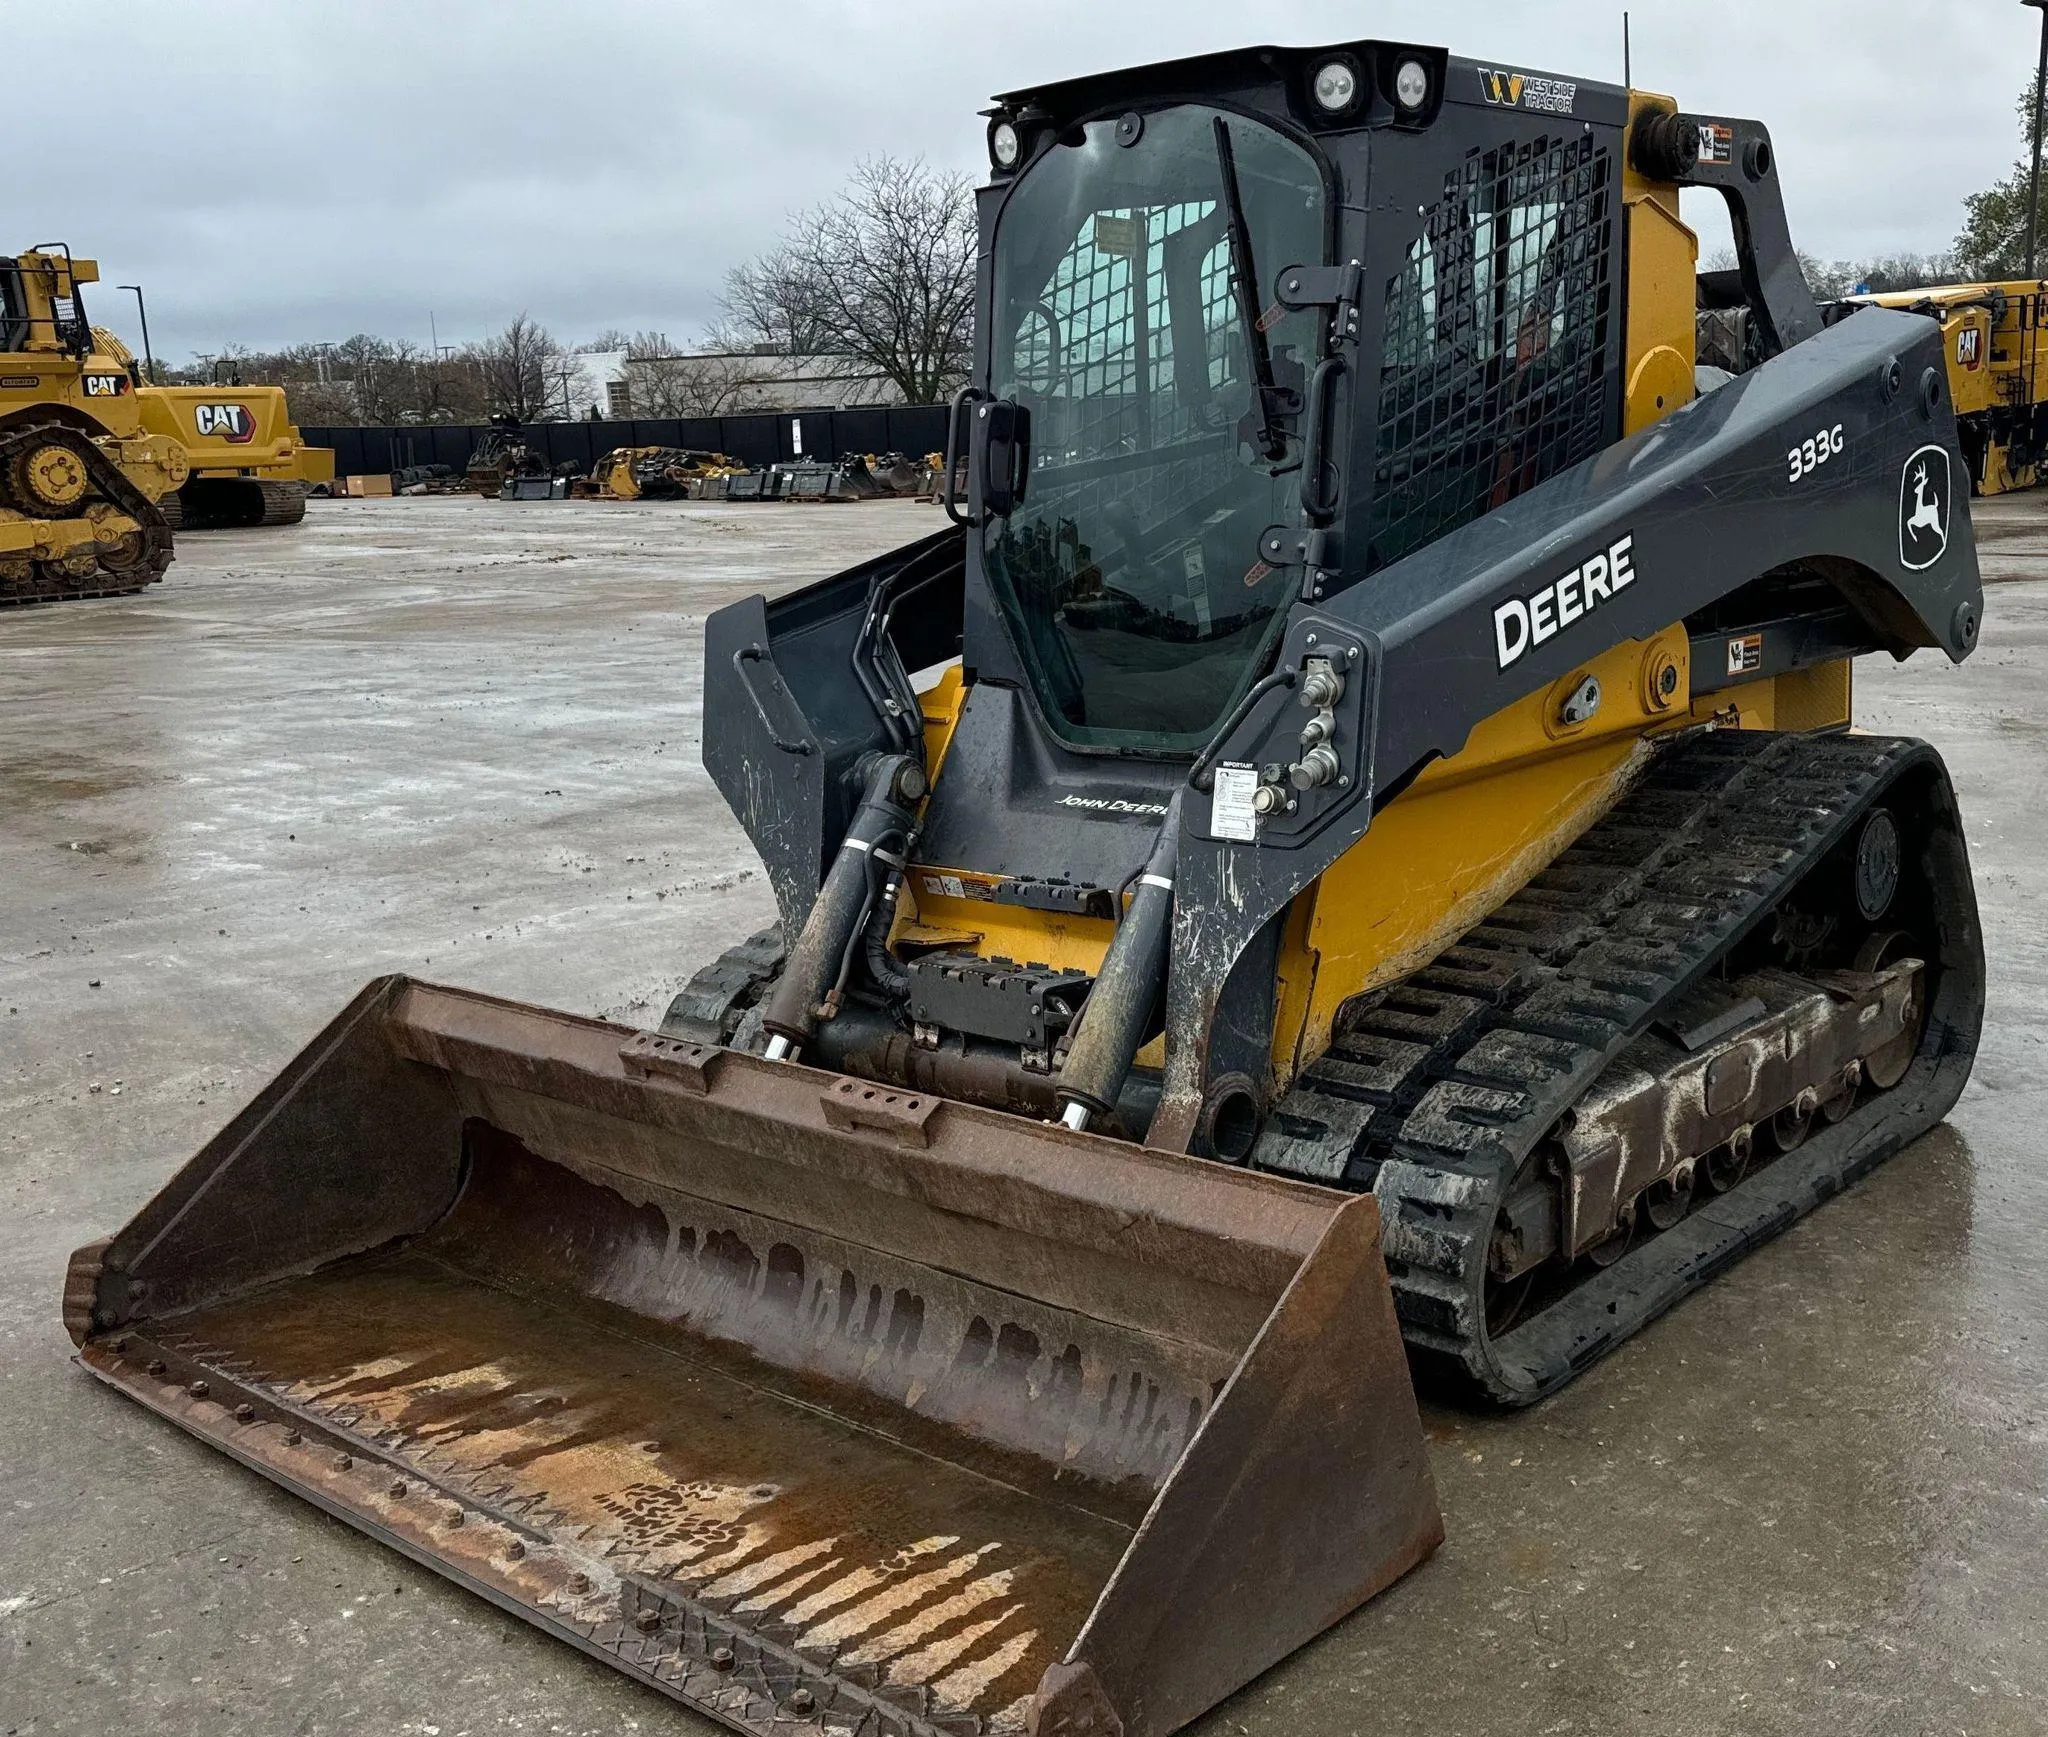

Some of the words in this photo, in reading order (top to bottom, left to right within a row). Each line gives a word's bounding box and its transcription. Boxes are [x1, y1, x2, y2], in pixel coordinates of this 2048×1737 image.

[1524, 77, 1552, 95] WEST
[1553, 81, 1576, 98] SIDE
[1523, 92, 1573, 113] TRACTOR
[1957, 329, 1979, 363] CAT
[87, 376, 116, 396] CAT
[196, 405, 241, 436] CAT
[1788, 423, 1844, 483] 333G
[1494, 534, 1636, 669] DEERE
[1222, 761, 1254, 770] IMPORTANT
[1054, 794, 1109, 809] JOHN
